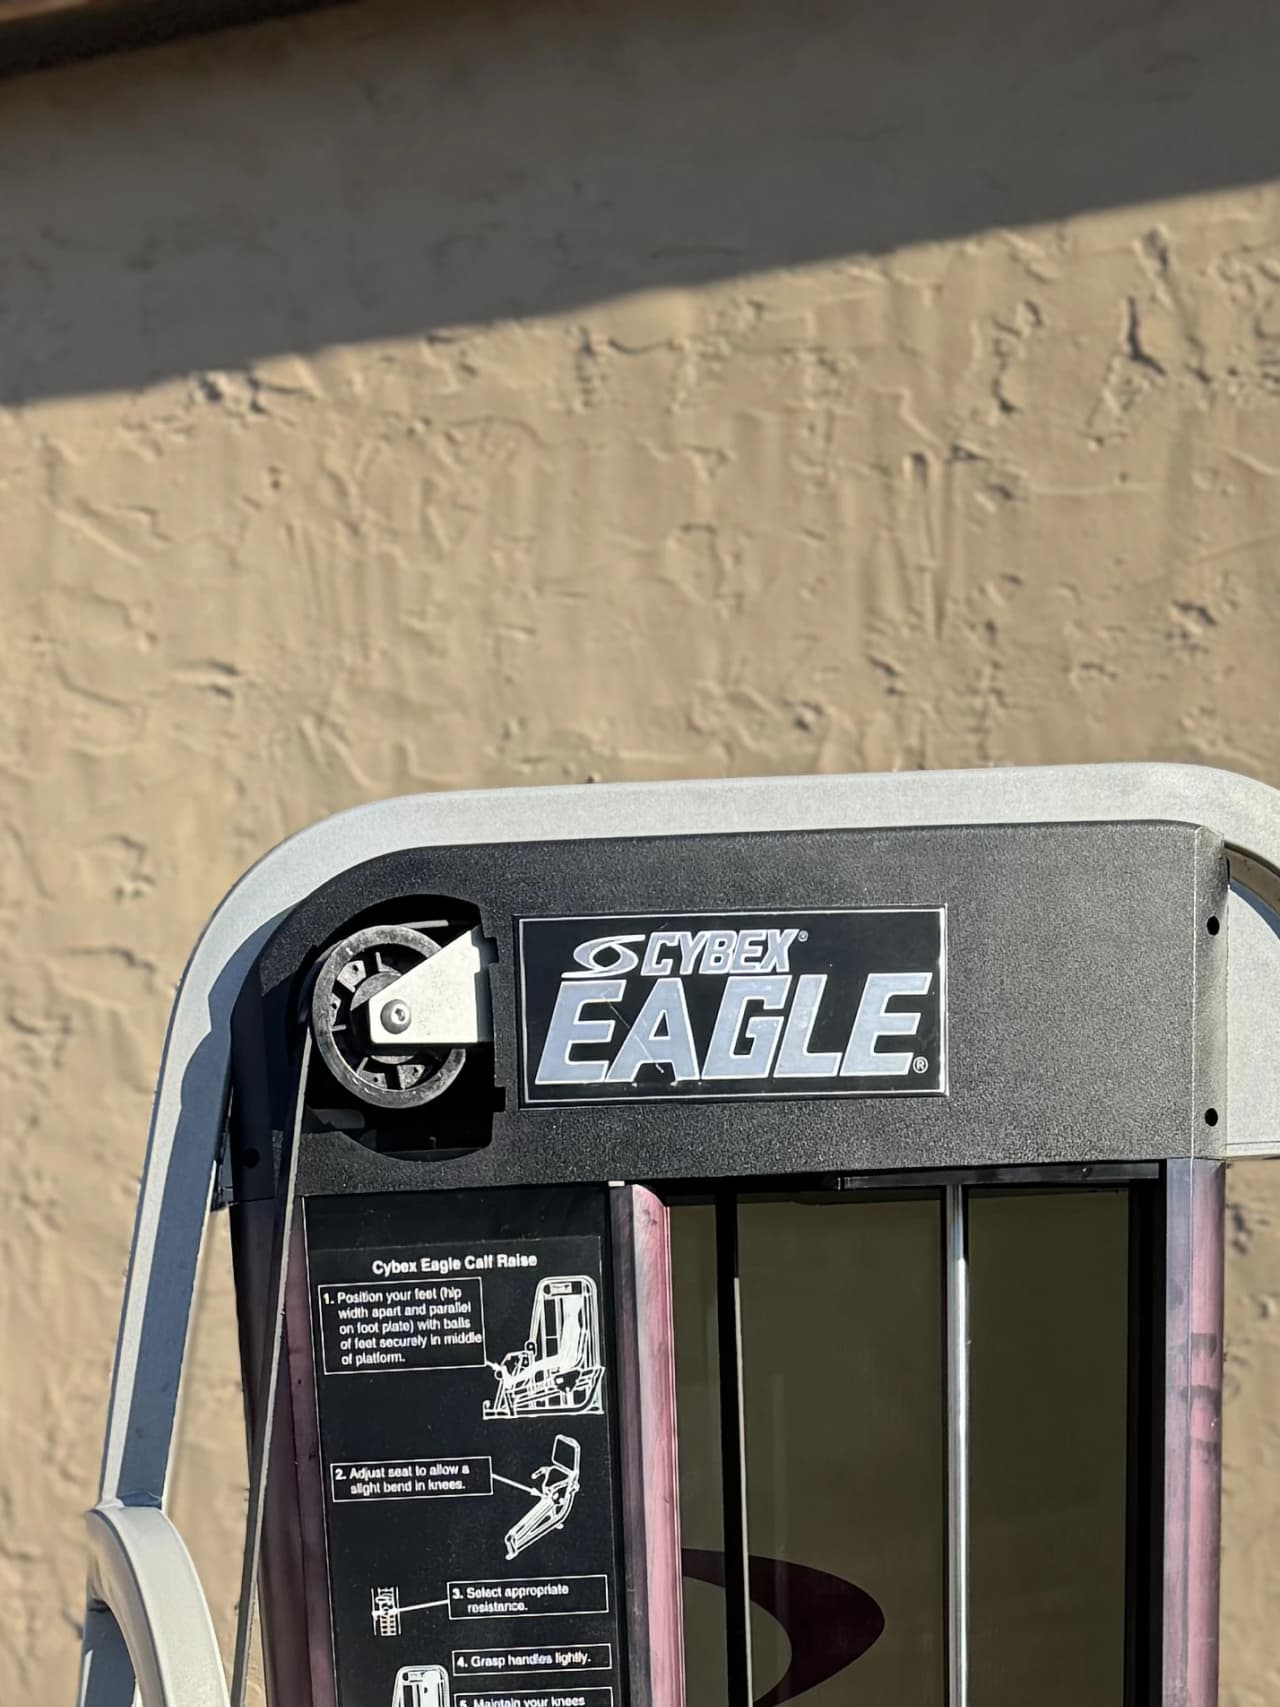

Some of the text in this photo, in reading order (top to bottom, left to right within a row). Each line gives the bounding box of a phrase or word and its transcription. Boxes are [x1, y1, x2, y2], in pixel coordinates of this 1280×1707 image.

[640, 929, 800, 977] CYBEX
[535, 973, 932, 1086] EAGLE
[372, 1253, 538, 1277] Cybex Eagle Calf Raise
[323, 1286, 462, 1304] 1. Position your feet (hip
[338, 1301, 472, 1321] width apart and parallel
[339, 1317, 471, 1335] on foot plate) with balls
[340, 1331, 483, 1351] of feet securely in middle
[341, 1351, 406, 1368] of platform.
[334, 1463, 470, 1481] 2. Adjust seat to allow a
[350, 1479, 466, 1497] slight bend in knees.
[452, 1583, 569, 1599] 3. Select appropriate
[467, 1601, 528, 1614] resistance.
[456, 1651, 592, 1669] 4. Grasp handles lightly.
[551, 1696, 586, 1707] knees
